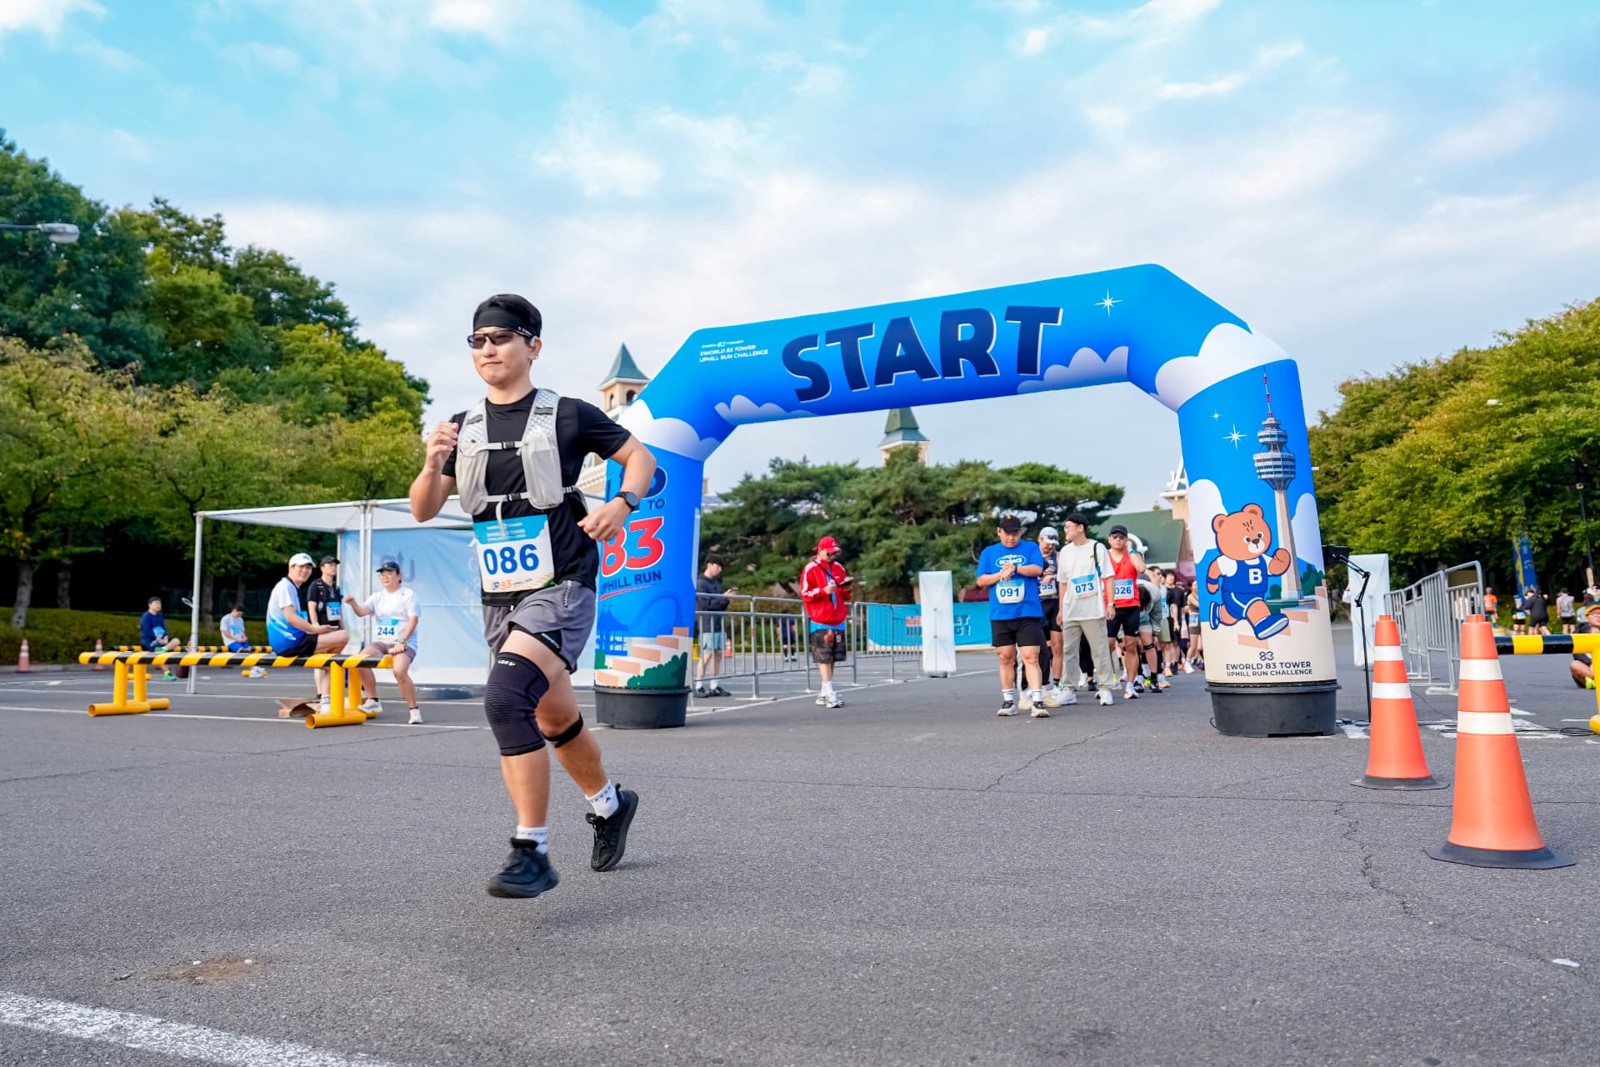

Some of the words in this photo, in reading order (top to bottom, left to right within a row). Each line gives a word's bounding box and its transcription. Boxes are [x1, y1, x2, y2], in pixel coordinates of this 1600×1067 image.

[782, 306, 1063, 403] START
[648, 499, 666, 510] TO
[601, 516, 665, 577] 83
[483, 543, 540, 575] 086
[634, 570, 662, 585] RUN
[1248, 568, 1263, 585] B
[1000, 588, 1020, 598] 091
[1075, 582, 1094, 594] 073
[1115, 586, 1132, 595] 026
[377, 626, 395, 636] 244
[1279, 661, 1312, 669] TOWER
[1269, 668, 1313, 677] CHALLENGE
